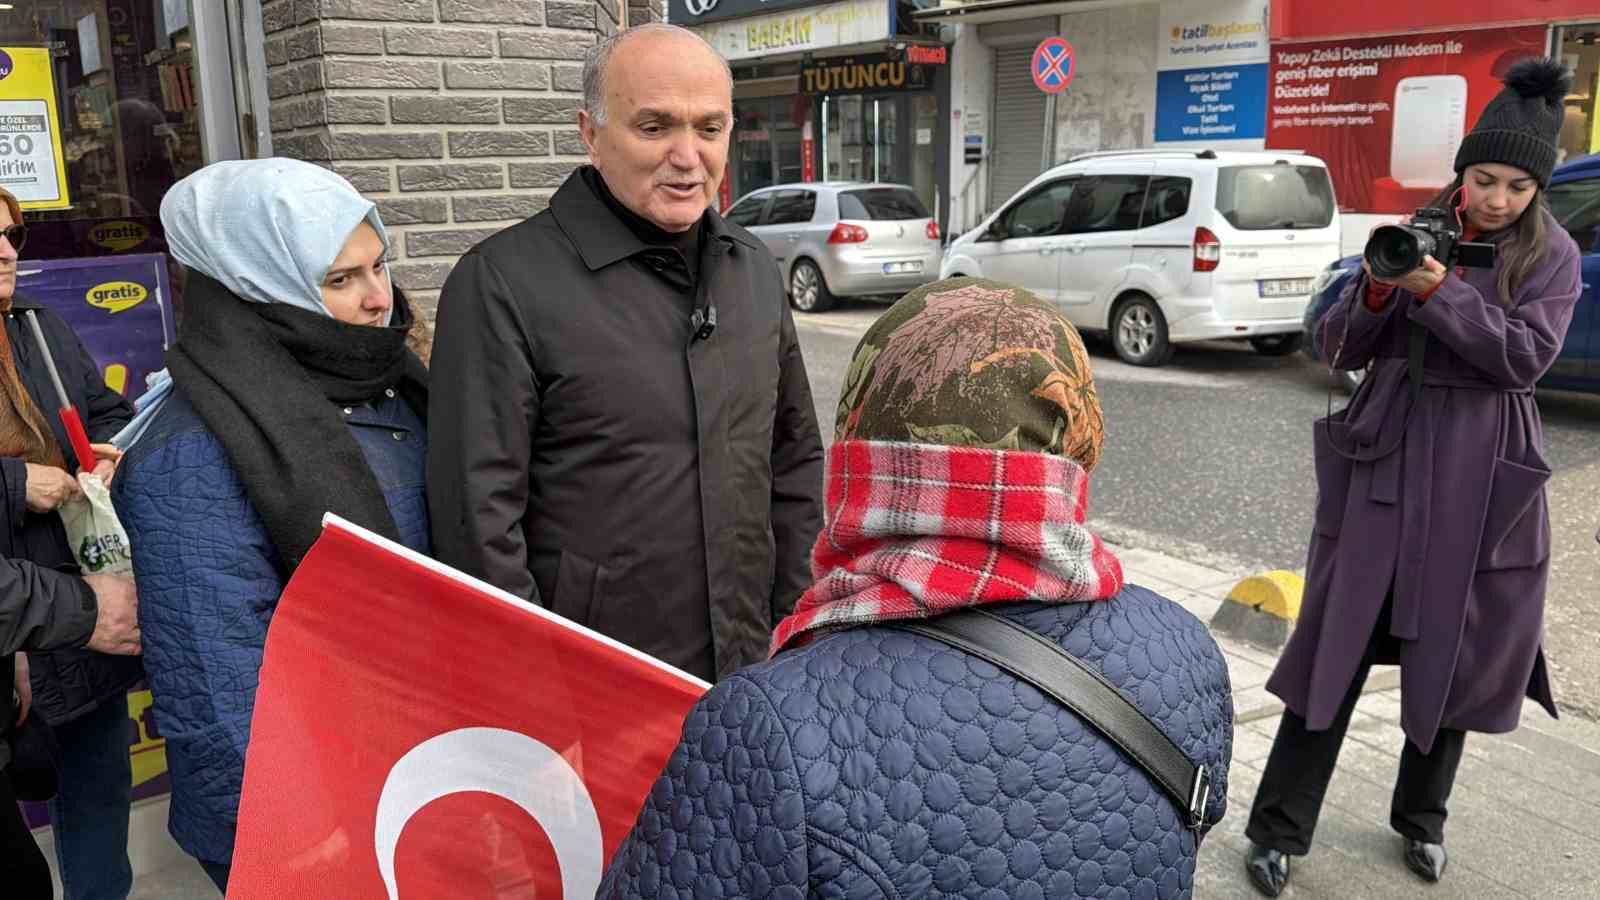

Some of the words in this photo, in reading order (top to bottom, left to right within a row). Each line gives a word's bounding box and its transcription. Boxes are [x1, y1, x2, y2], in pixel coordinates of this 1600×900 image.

[746, 16, 811, 50] BABAM
[1277, 51, 1312, 67] Yapay
[1343, 46, 1392, 61] Destekli
[1394, 43, 1444, 58] Modem
[1445, 40, 1464, 54] ile
[1275, 68, 1307, 84] geniş
[1307, 65, 1337, 79] fiber
[1338, 62, 1379, 79] erişimi
[95, 225, 140, 242] gratis
[93, 285, 141, 303] gratis
